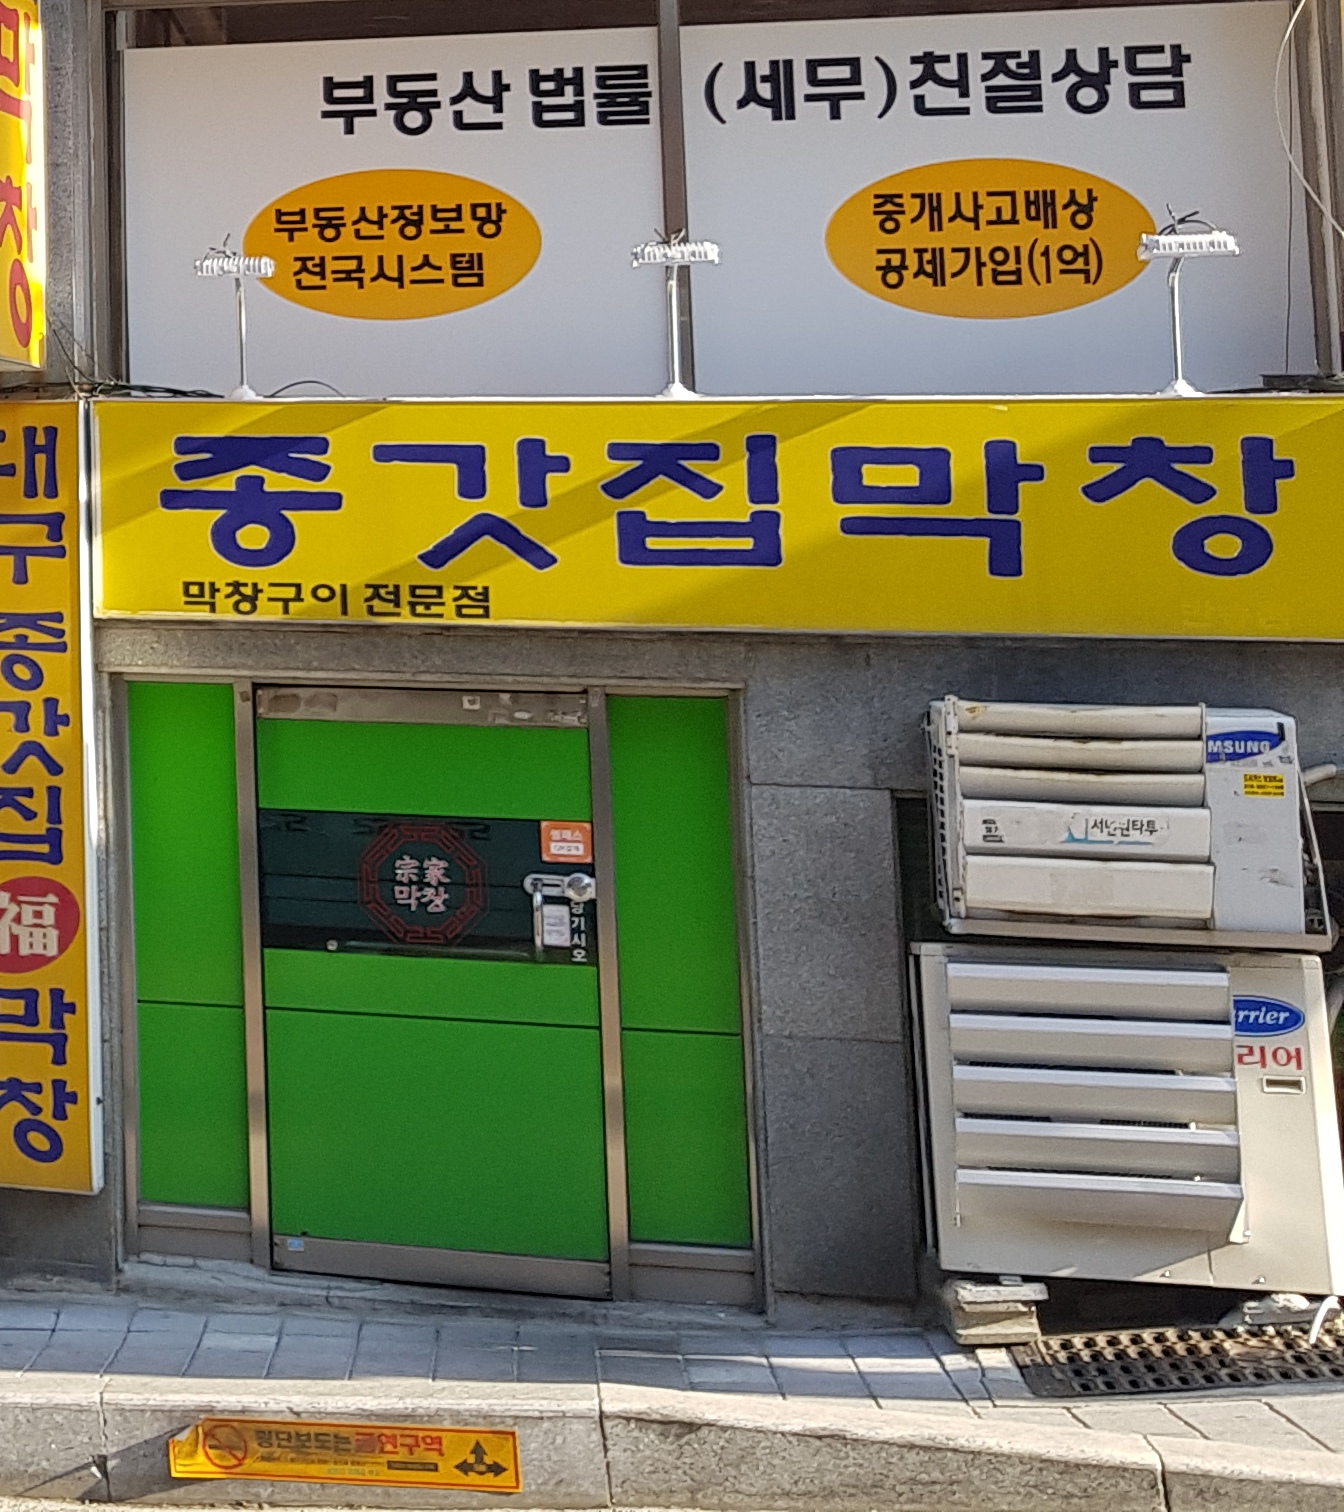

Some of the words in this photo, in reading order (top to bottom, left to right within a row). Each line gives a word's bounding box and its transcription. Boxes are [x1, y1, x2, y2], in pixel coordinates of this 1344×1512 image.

[320, 68, 511, 136] 부동산
[527, 63, 654, 129] 법률
[703, 42, 1193, 125] (세무)친절상담
[273, 200, 507, 243] 부동산정보망
[872, 187, 1099, 235] 중개사고배상
[292, 251, 485, 291] 전국시스템
[874, 237, 1105, 290] 공제가입(1억)
[182, 579, 349, 616] 막창구이
[363, 583, 491, 619] 전문점
[1207, 739, 1270, 754] MSUNG
[1236, 1005, 1290, 1025] rrier
[1235, 1044, 1303, 1071] 리어
